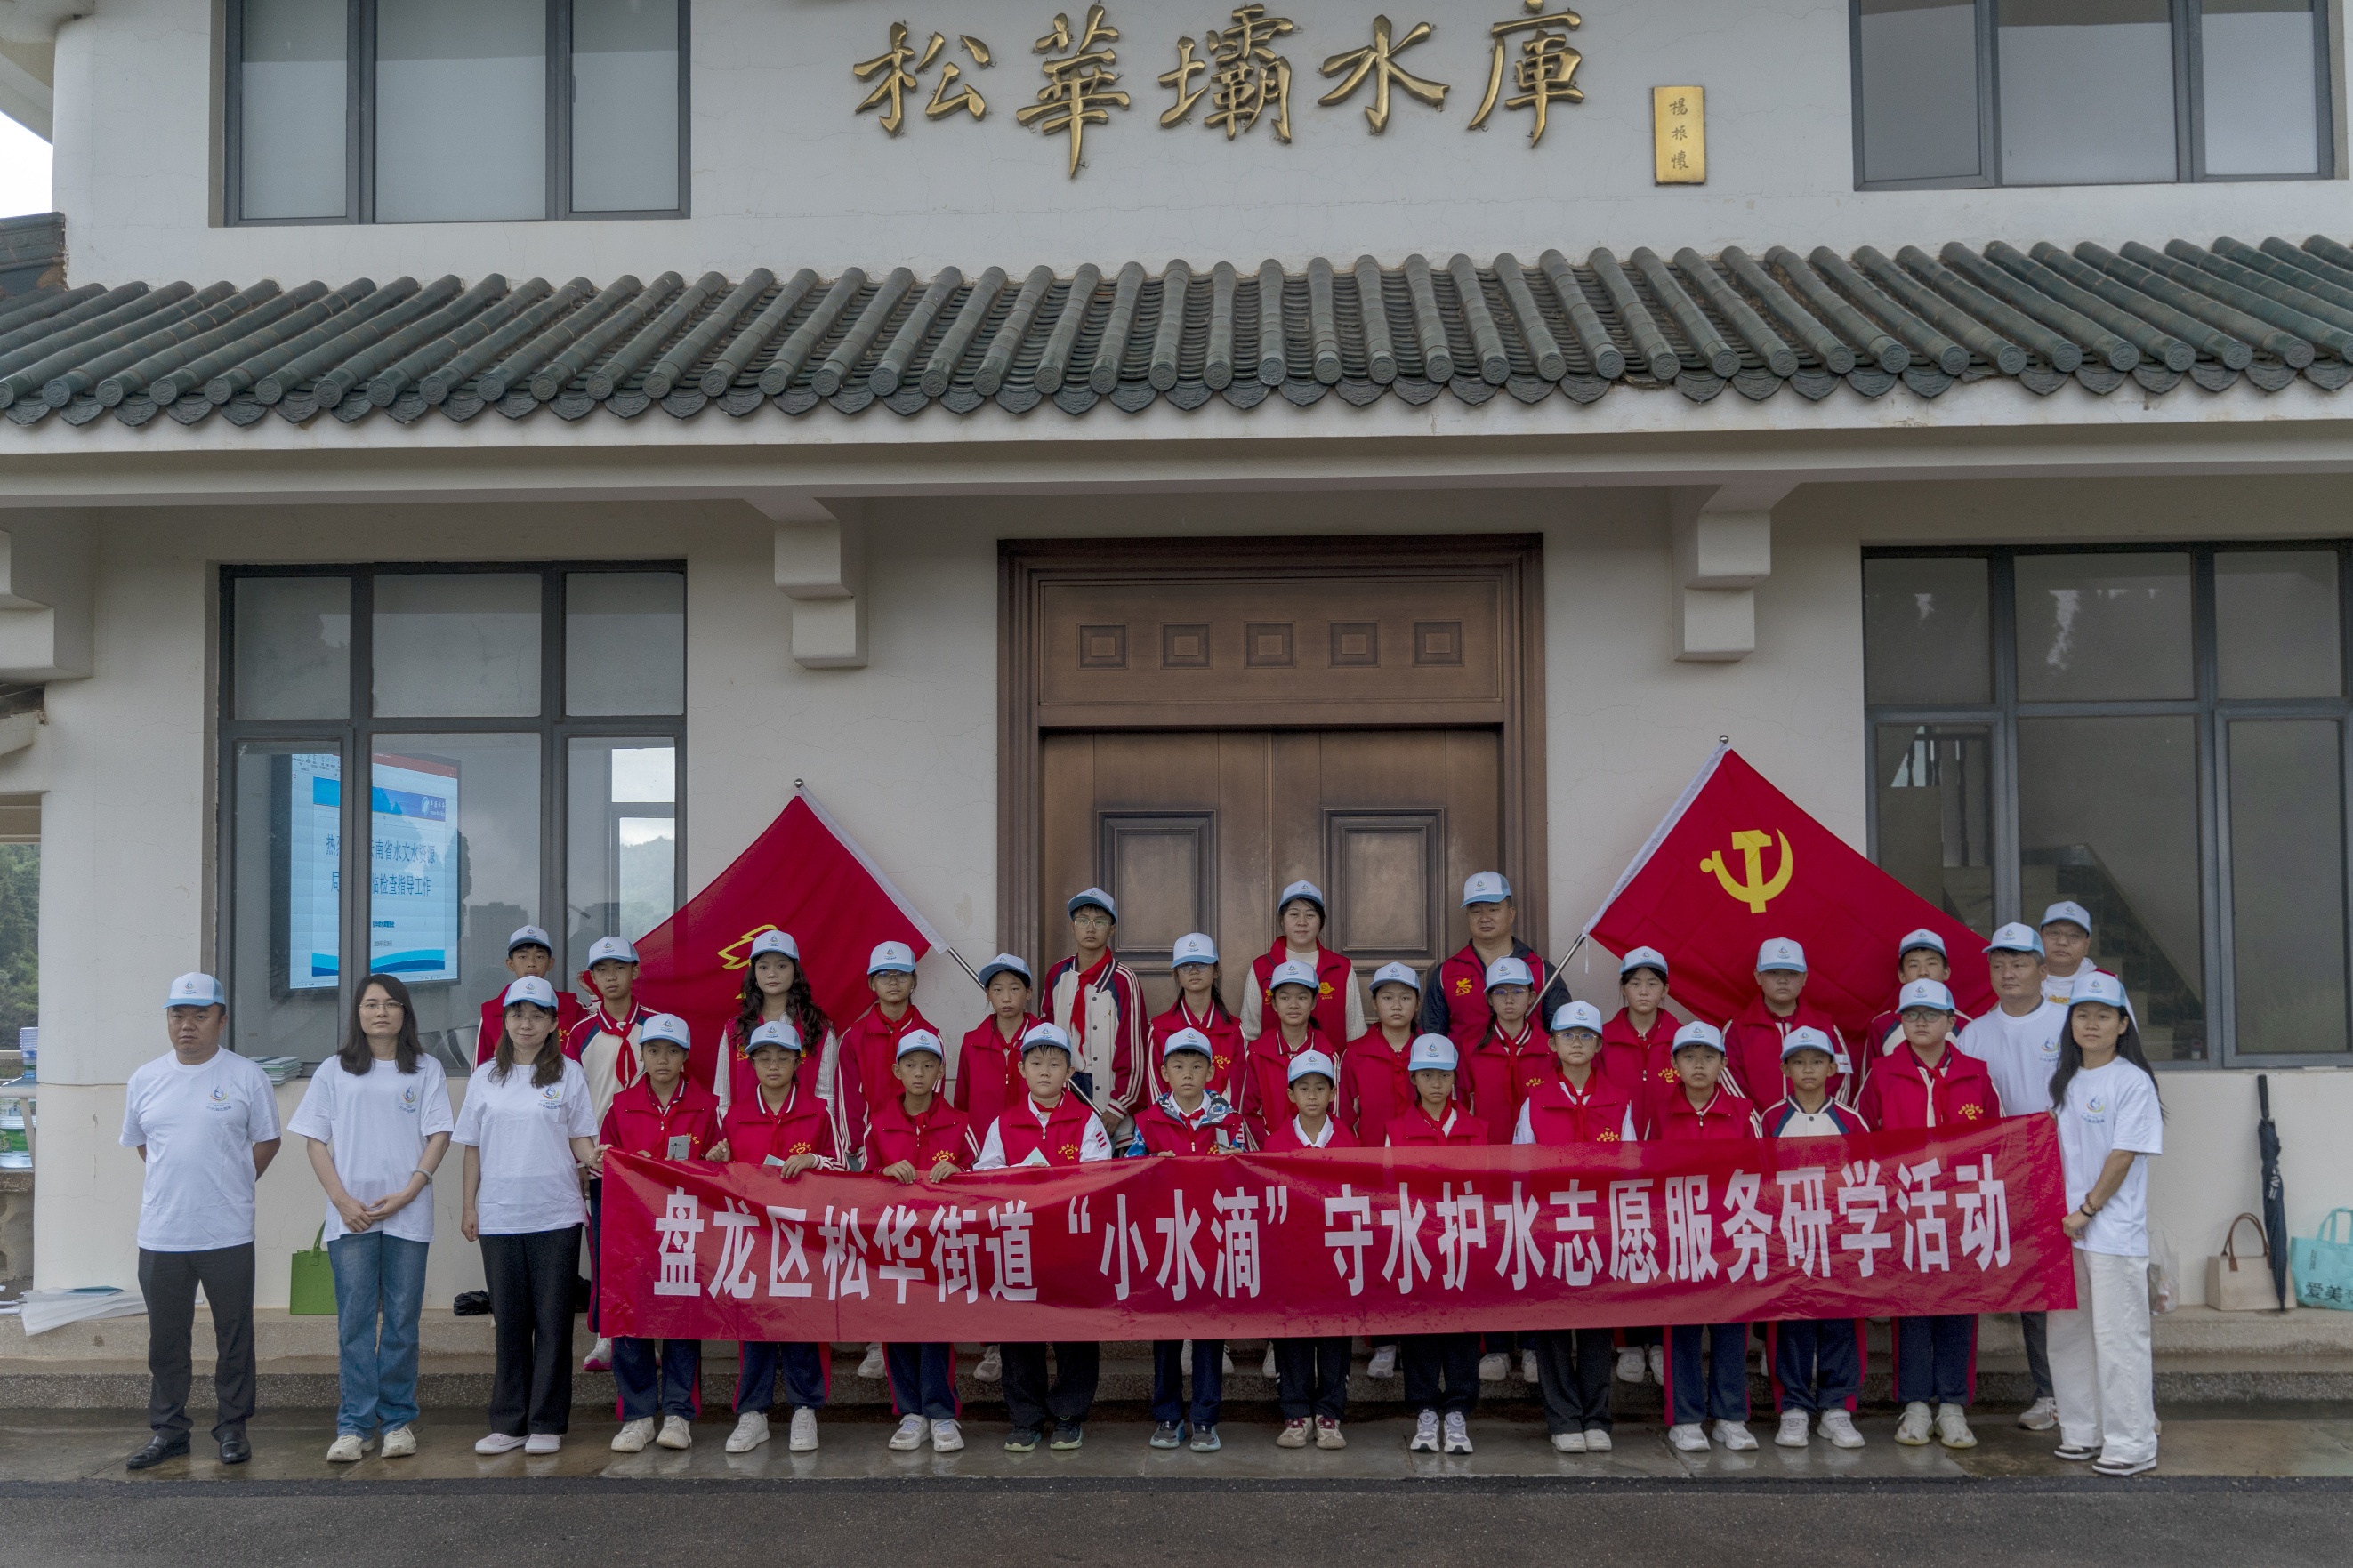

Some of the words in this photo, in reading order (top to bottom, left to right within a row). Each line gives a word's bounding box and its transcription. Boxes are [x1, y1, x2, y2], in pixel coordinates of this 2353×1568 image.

[852, 0, 1585, 179] 松華壩水庫
